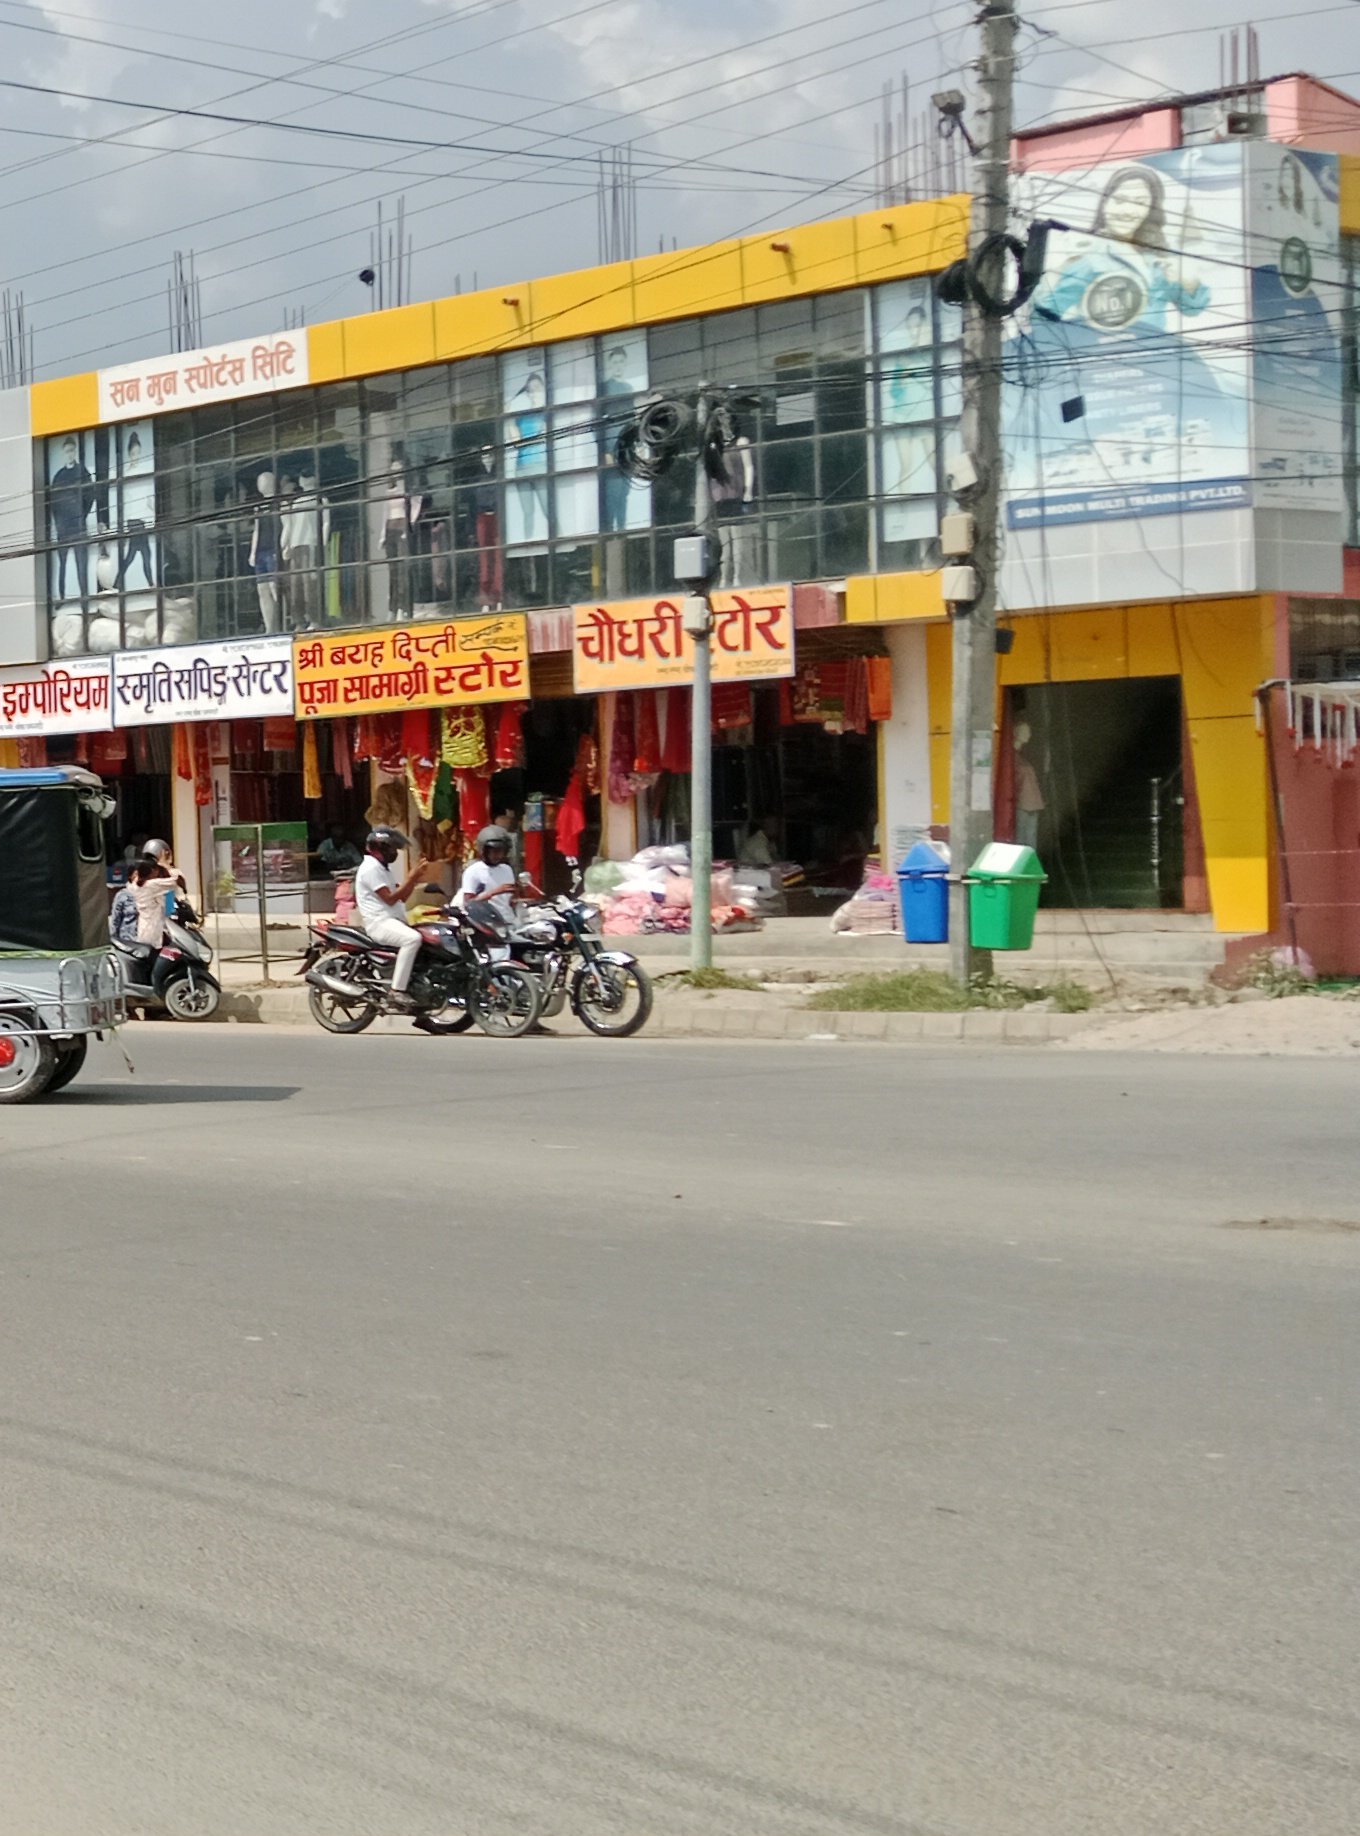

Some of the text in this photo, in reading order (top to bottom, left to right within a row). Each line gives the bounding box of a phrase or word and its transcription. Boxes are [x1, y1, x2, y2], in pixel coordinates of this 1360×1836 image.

[109, 377, 140, 408] सन
[147, 371, 178, 406] मुन
[251, 341, 296, 381] सिटि
[298, 642, 324, 670] श्री
[330, 641, 385, 668] बराह
[391, 625, 457, 661] दिप्ती
[577, 600, 683, 663] चौधरी
[2, 669, 110, 722] इम्पोरियम
[116, 661, 173, 714] स्मृति
[231, 655, 291, 698] सेन्टर
[297, 651, 523, 715] पूजा सामाग्री स्टोर
